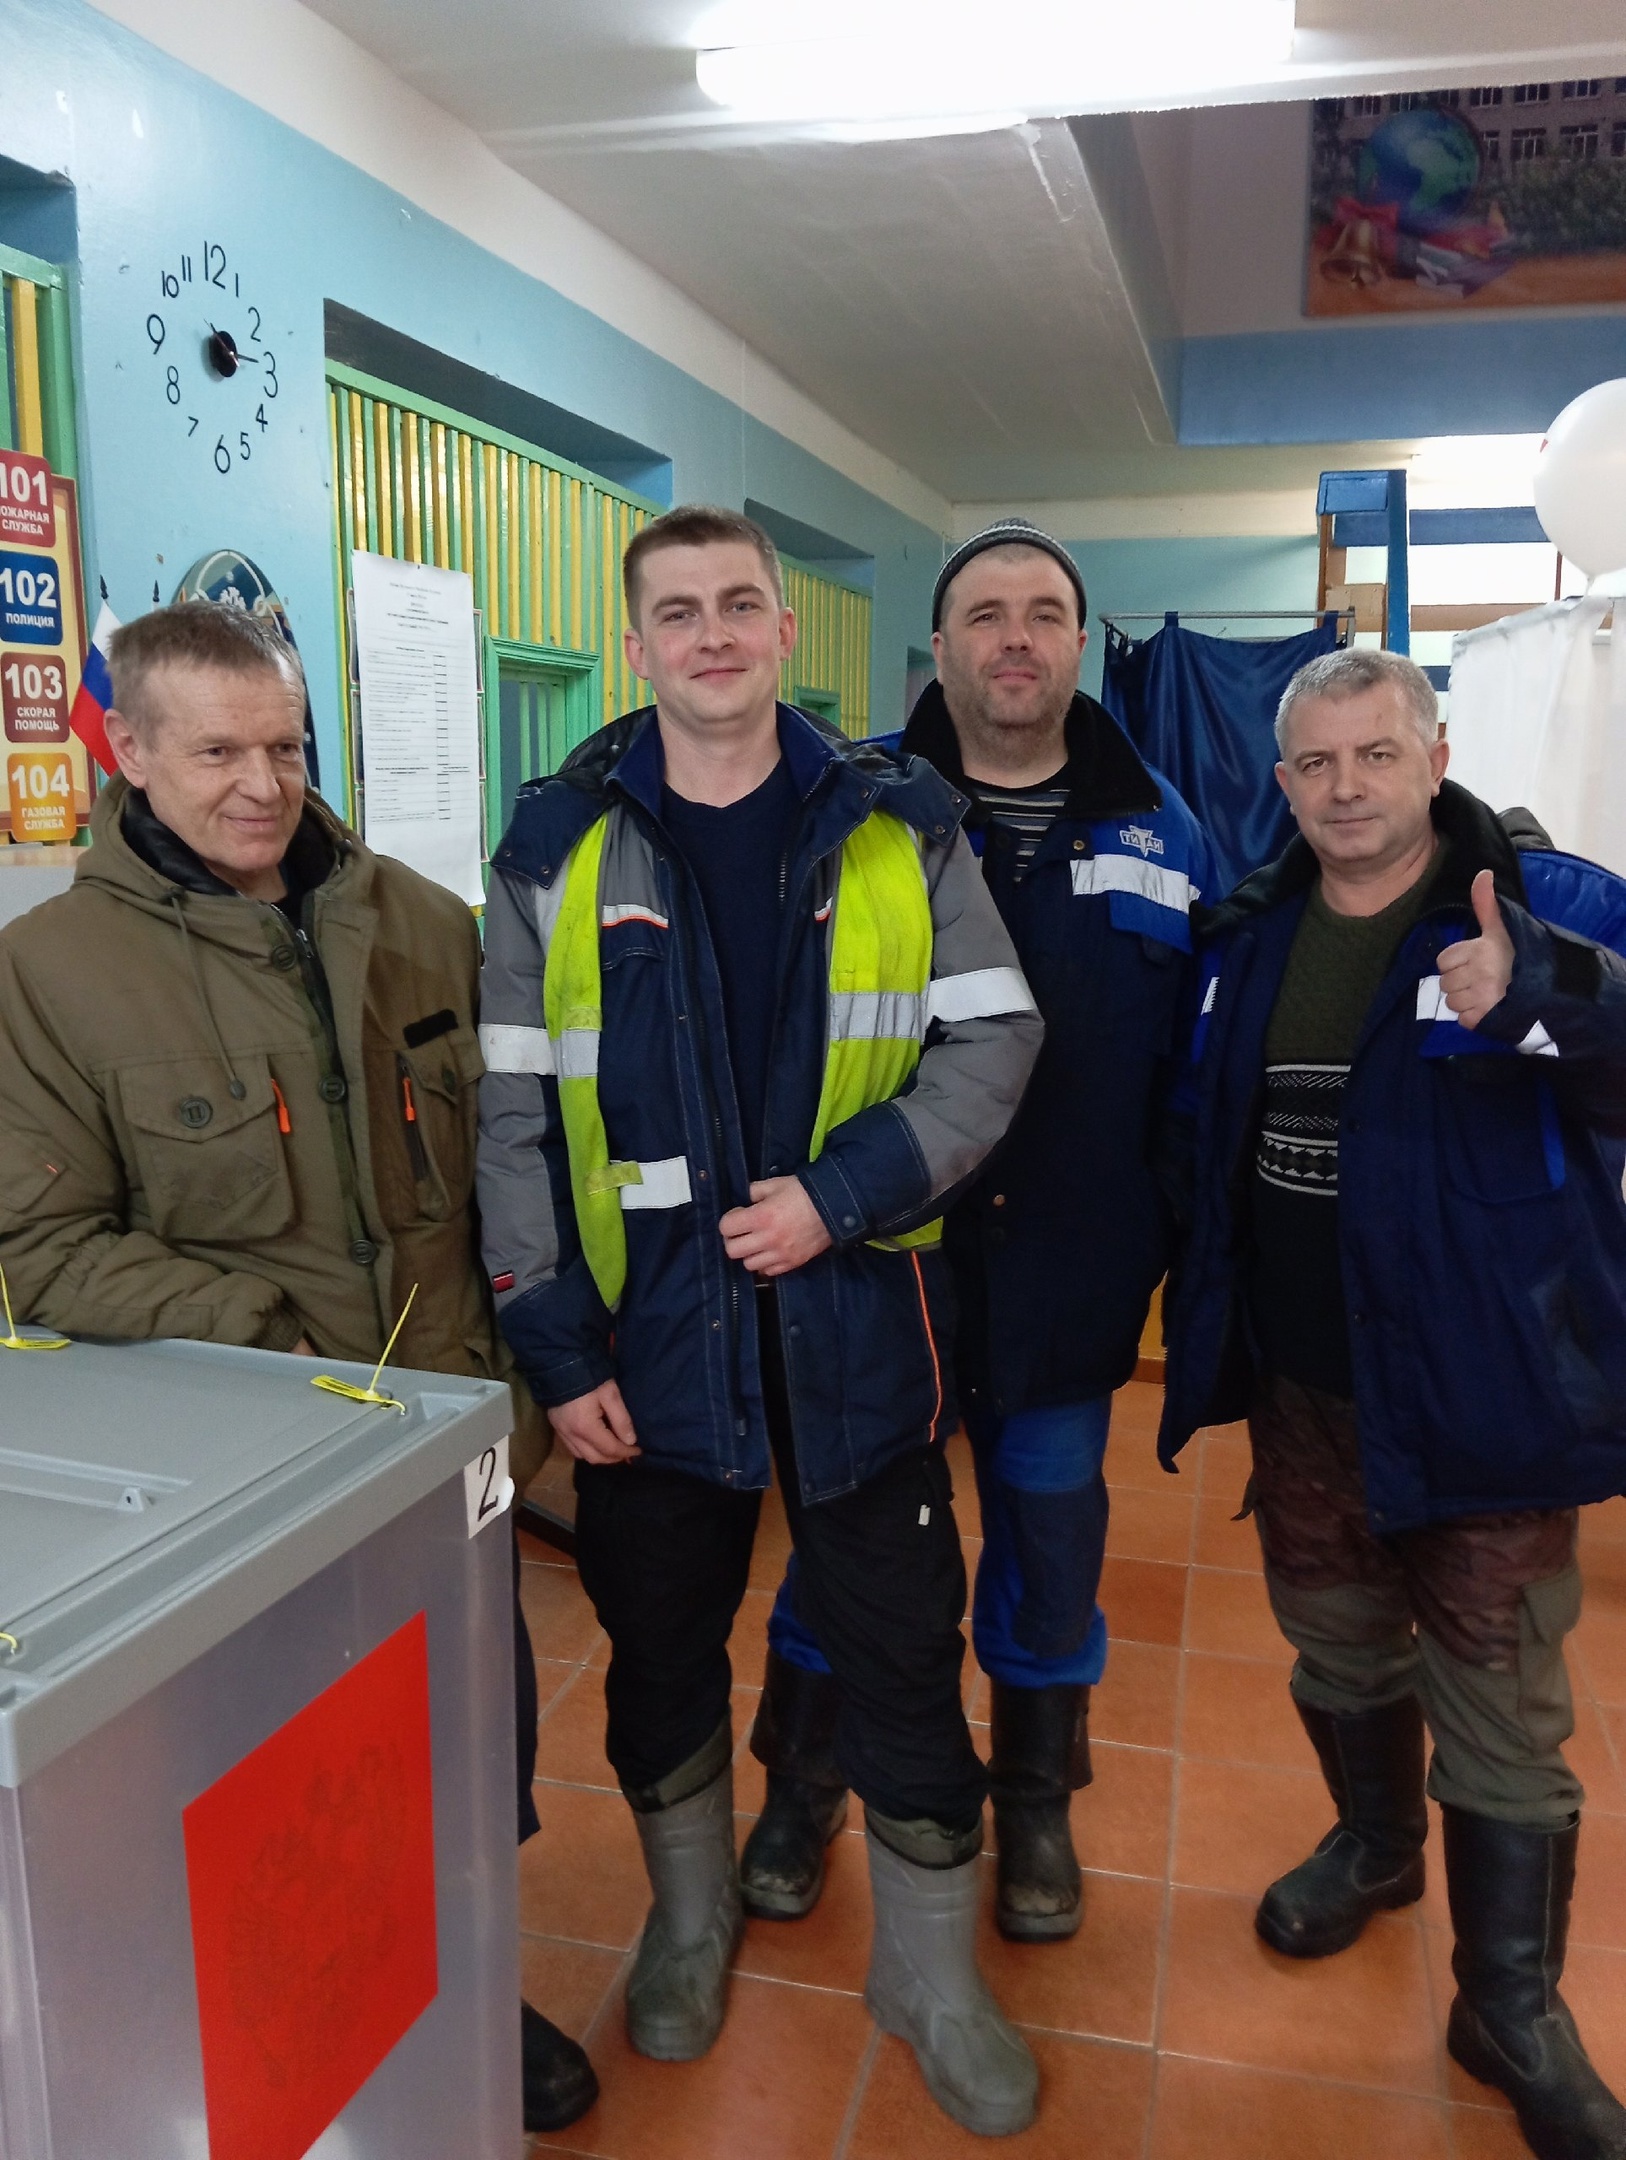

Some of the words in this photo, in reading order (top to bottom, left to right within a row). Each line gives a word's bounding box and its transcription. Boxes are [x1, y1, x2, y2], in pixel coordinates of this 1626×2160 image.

[181, 254, 192, 283] 11
[204, 240, 226, 290] 12
[161, 270, 180, 298] 10
[234, 272, 239, 298] 1
[146, 313, 166, 355] 9
[248, 306, 261, 342] 2
[166, 365, 180, 405] 8
[263, 351, 278, 398] 3
[187, 416, 199, 437] 7
[255, 403, 268, 433] 4
[214, 434, 231, 474] 6
[239, 431, 251, 460] 5
[0, 462, 48, 506] 101
[0, 505, 50, 524] ОЖАРНАЯ
[2, 518, 44, 536] СЛУЖБА
[0, 567, 57, 608] 102
[5, 612, 55, 628] ПОЛИЦИЯ
[5, 663, 63, 700] 103
[15, 719, 60, 732] ПОМОЩЬ
[17, 706, 56, 718] СКОРАЯ
[12, 764, 70, 799] 104
[21, 806, 66, 818] ГАЗОВАЯ
[24, 818, 65, 830] СЛУЖБА
[478, 1447, 498, 1521] 2
